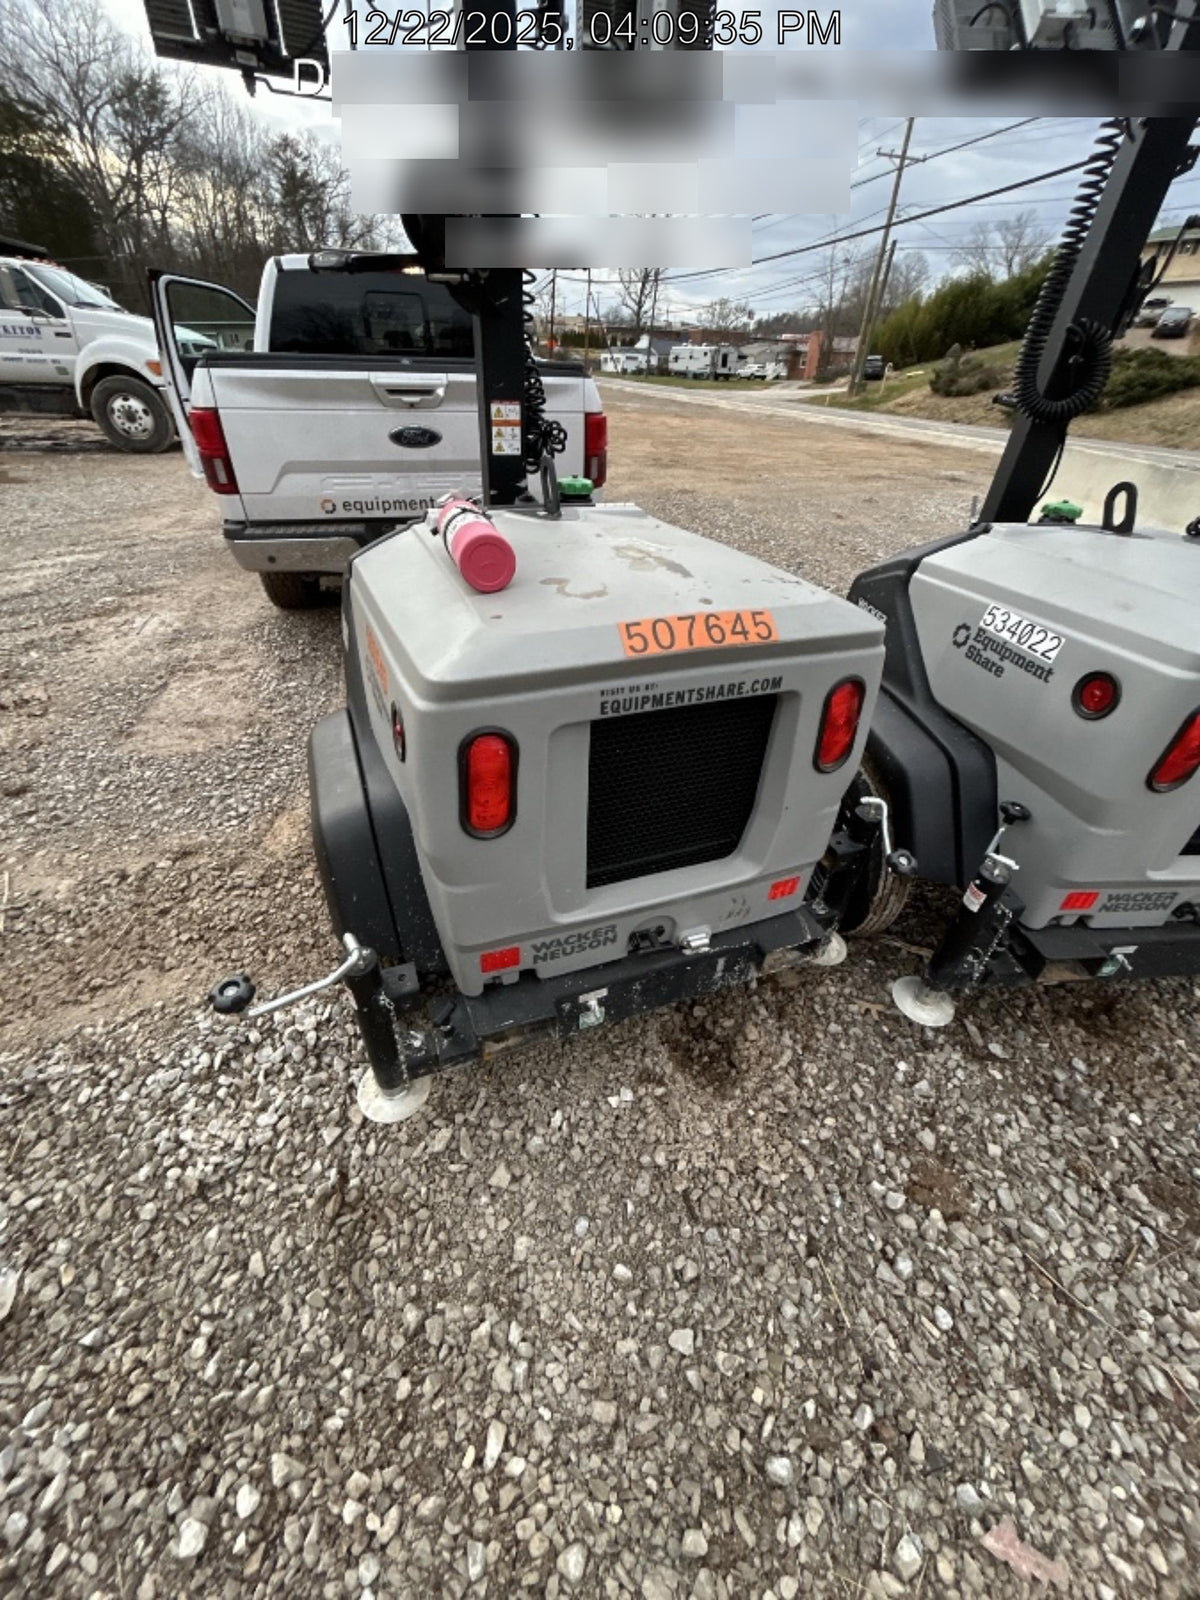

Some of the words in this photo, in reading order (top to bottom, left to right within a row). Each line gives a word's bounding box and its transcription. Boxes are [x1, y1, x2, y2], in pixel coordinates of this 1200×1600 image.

[342, 496, 436, 514] equipment
[625, 611, 773, 654] 507645
[982, 605, 1064, 661] 534022
[965, 644, 1006, 679] Share
[972, 627, 1055, 684] Equipment
[599, 676, 784, 715] EQUIPMENTSHARE.COM
[1098, 902, 1172, 913] NEUSON
[1106, 891, 1179, 903] WACKER
[530, 924, 618, 954] WACKER
[532, 934, 618, 964] NEUSON
